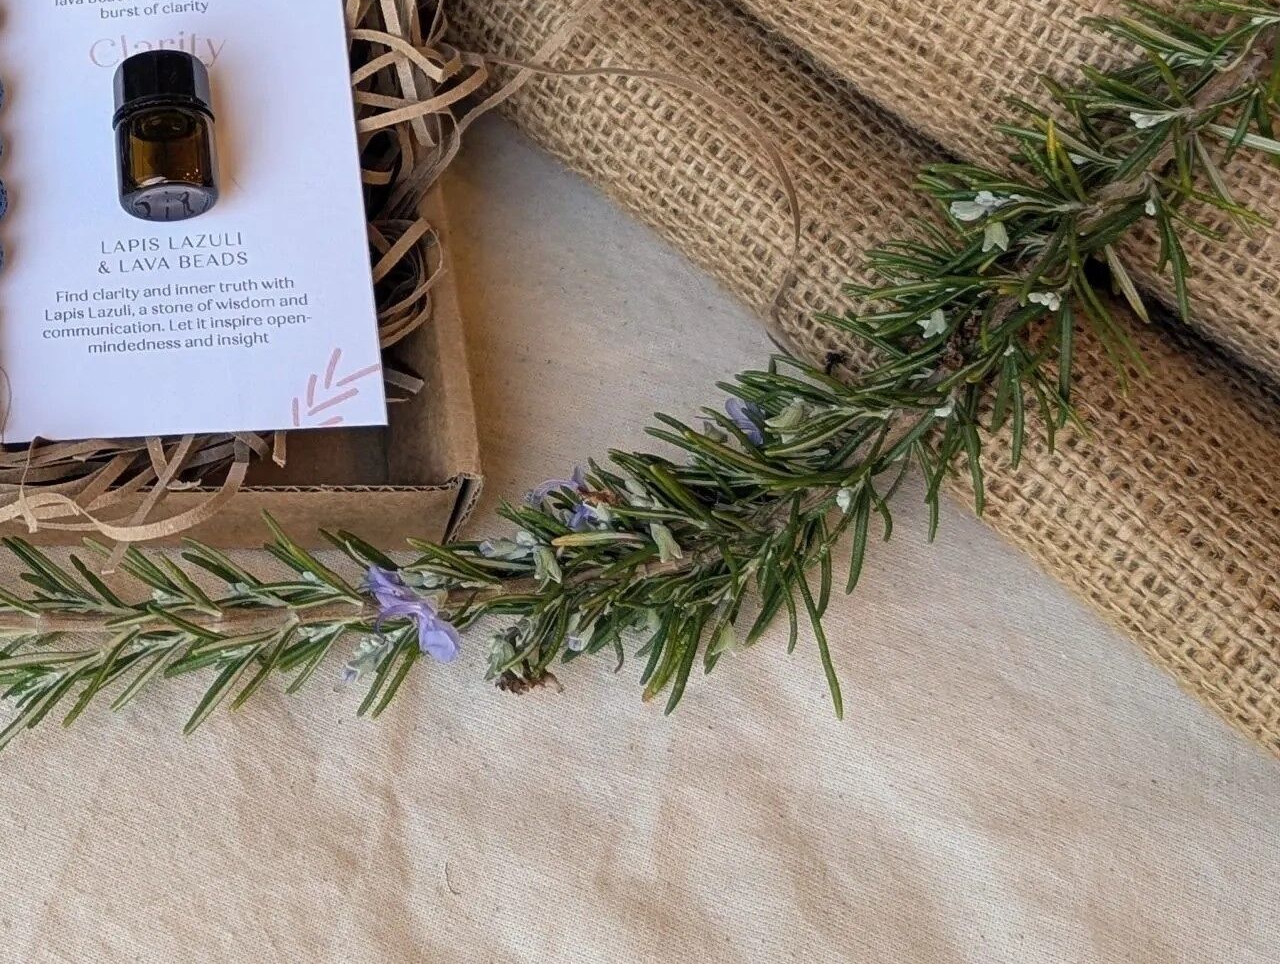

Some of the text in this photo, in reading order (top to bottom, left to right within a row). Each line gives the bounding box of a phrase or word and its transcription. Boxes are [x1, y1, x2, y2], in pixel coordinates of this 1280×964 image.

[100, 0, 208, 19] burst of clarity
[101, 231, 241, 254] LAPIS LAZULI
[97, 251, 248, 274] & LAVA BEADS
[55, 276, 294, 303] Find clarity and inner truth with
[44, 292, 308, 323] Lapis Lazuli, a stone of wisdom and
[42, 314, 312, 338] communication. Let it inspire open-
[87, 331, 269, 353] mindedness and insight
